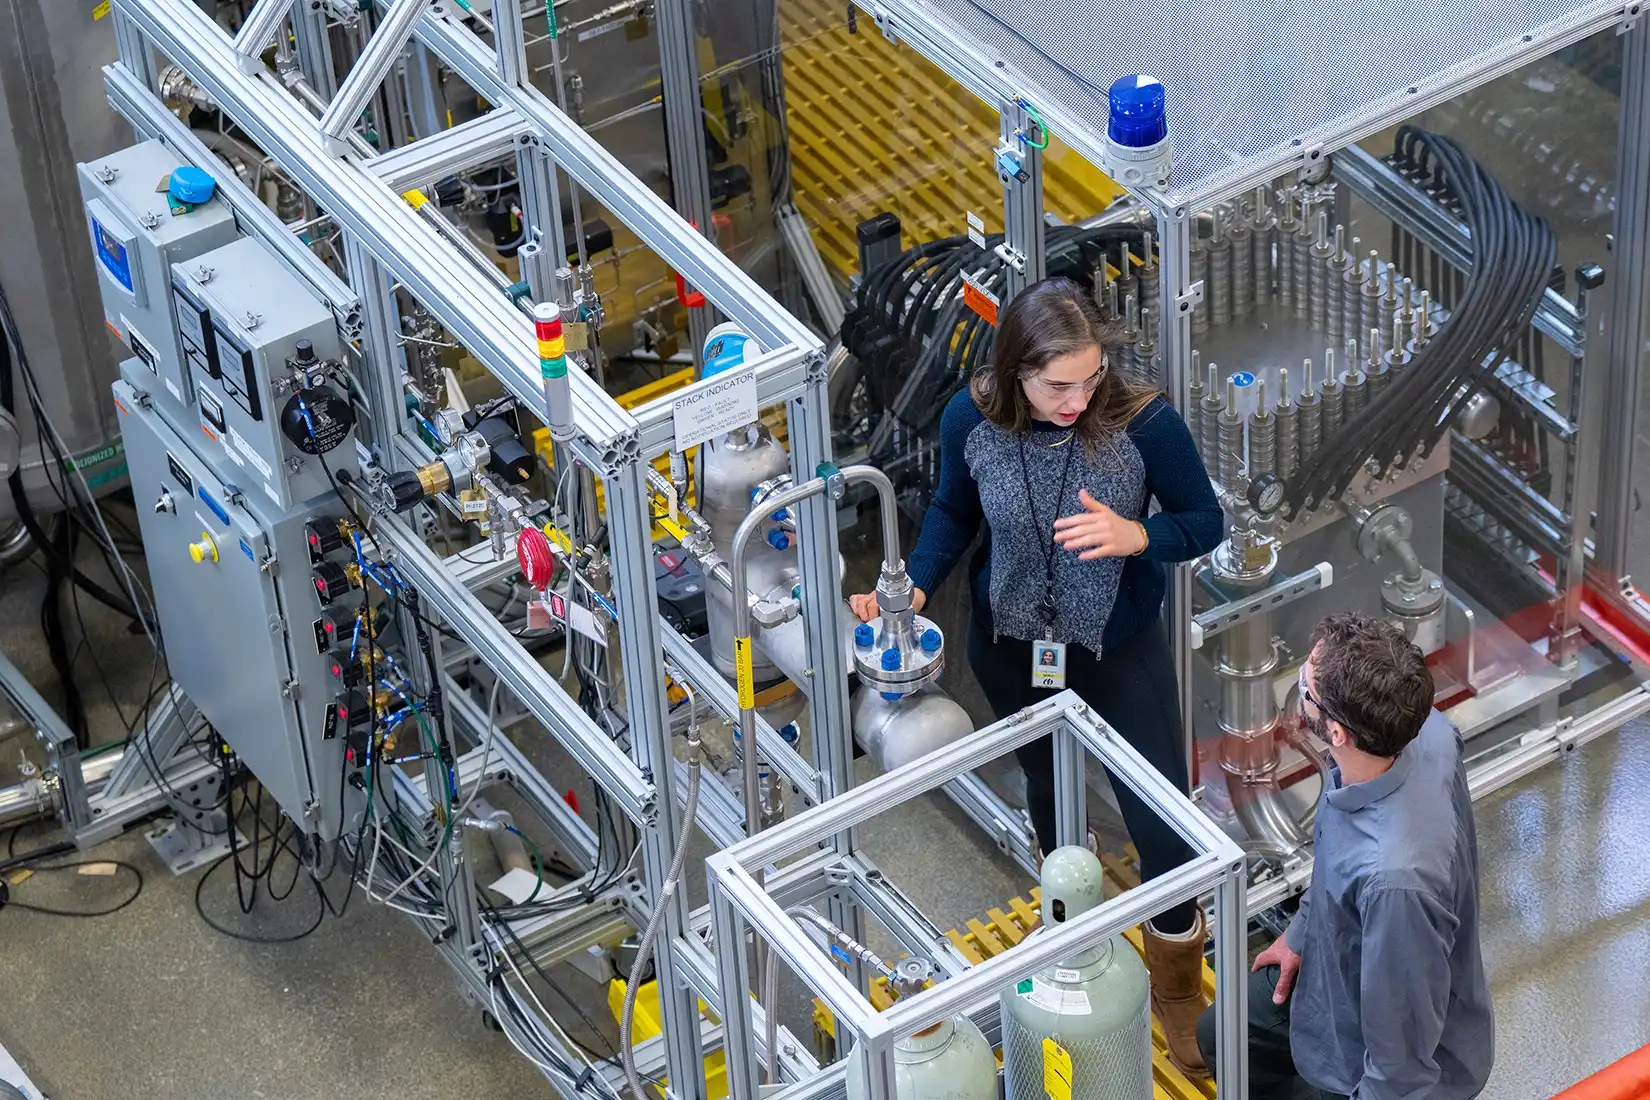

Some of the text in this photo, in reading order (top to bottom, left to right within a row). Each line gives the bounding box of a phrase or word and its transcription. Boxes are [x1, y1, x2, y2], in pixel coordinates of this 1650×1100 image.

[675, 372, 754, 410] STACK INDICATOR
[716, 399, 739, 411] WARNING
[737, 408, 752, 418] ONLY
[691, 424, 726, 442] NOTIFICATION
[738, 674, 747, 708] HYDROGEN
